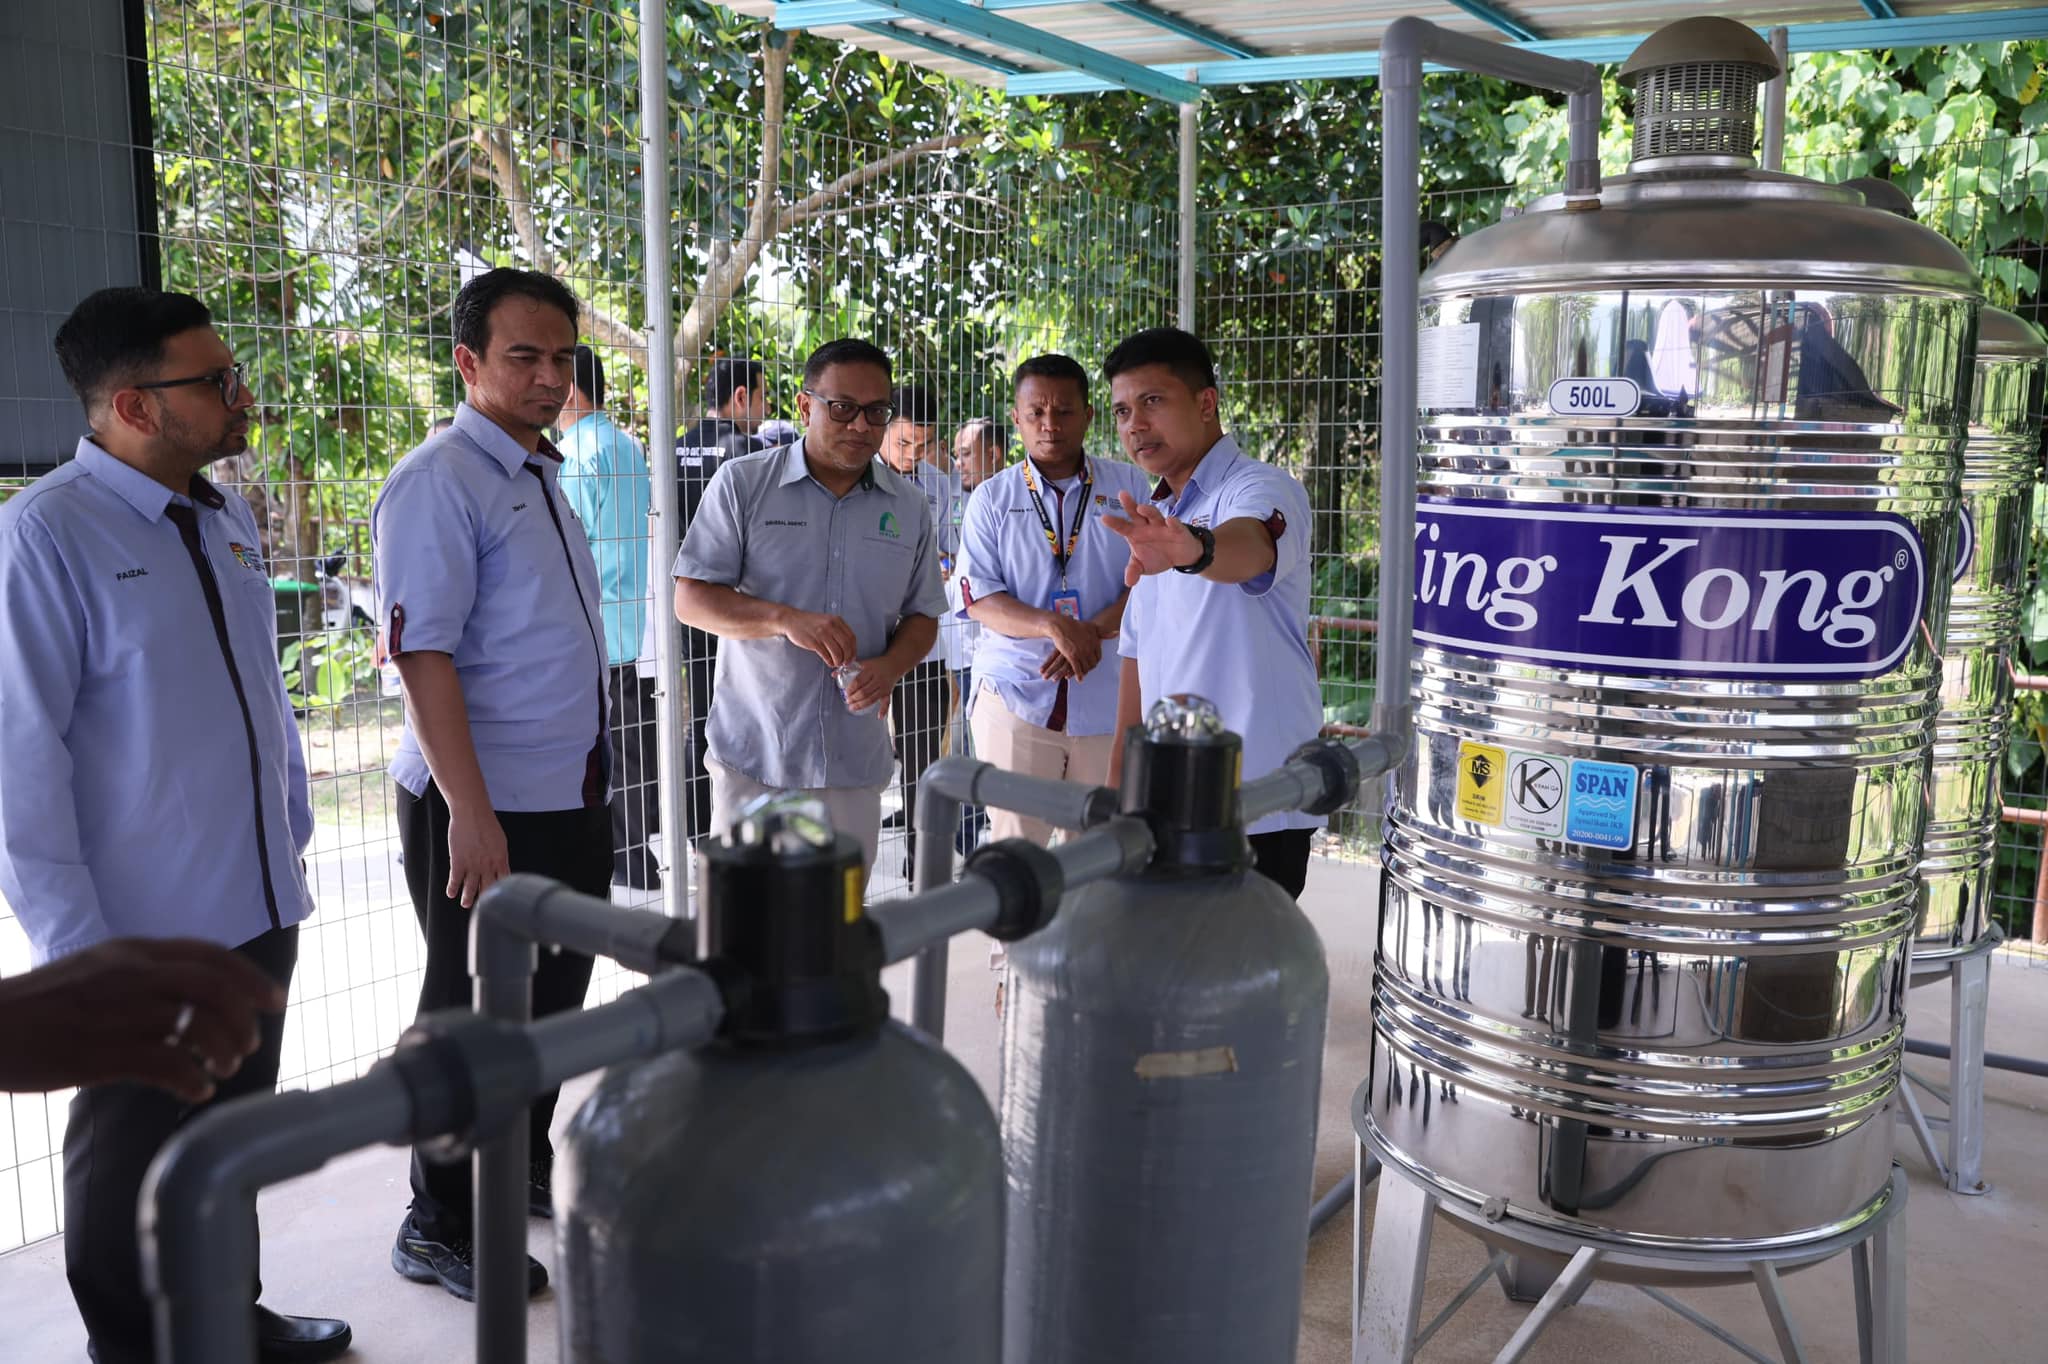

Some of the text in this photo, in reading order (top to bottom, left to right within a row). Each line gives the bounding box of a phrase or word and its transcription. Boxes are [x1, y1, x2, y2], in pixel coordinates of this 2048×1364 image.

[1568, 385, 1616, 408] 500L
[116, 567, 149, 581] FAIZAL
[1413, 522, 1558, 632] ing
[1472, 760, 1490, 775] MS
[1575, 772, 1629, 798] SPAN
